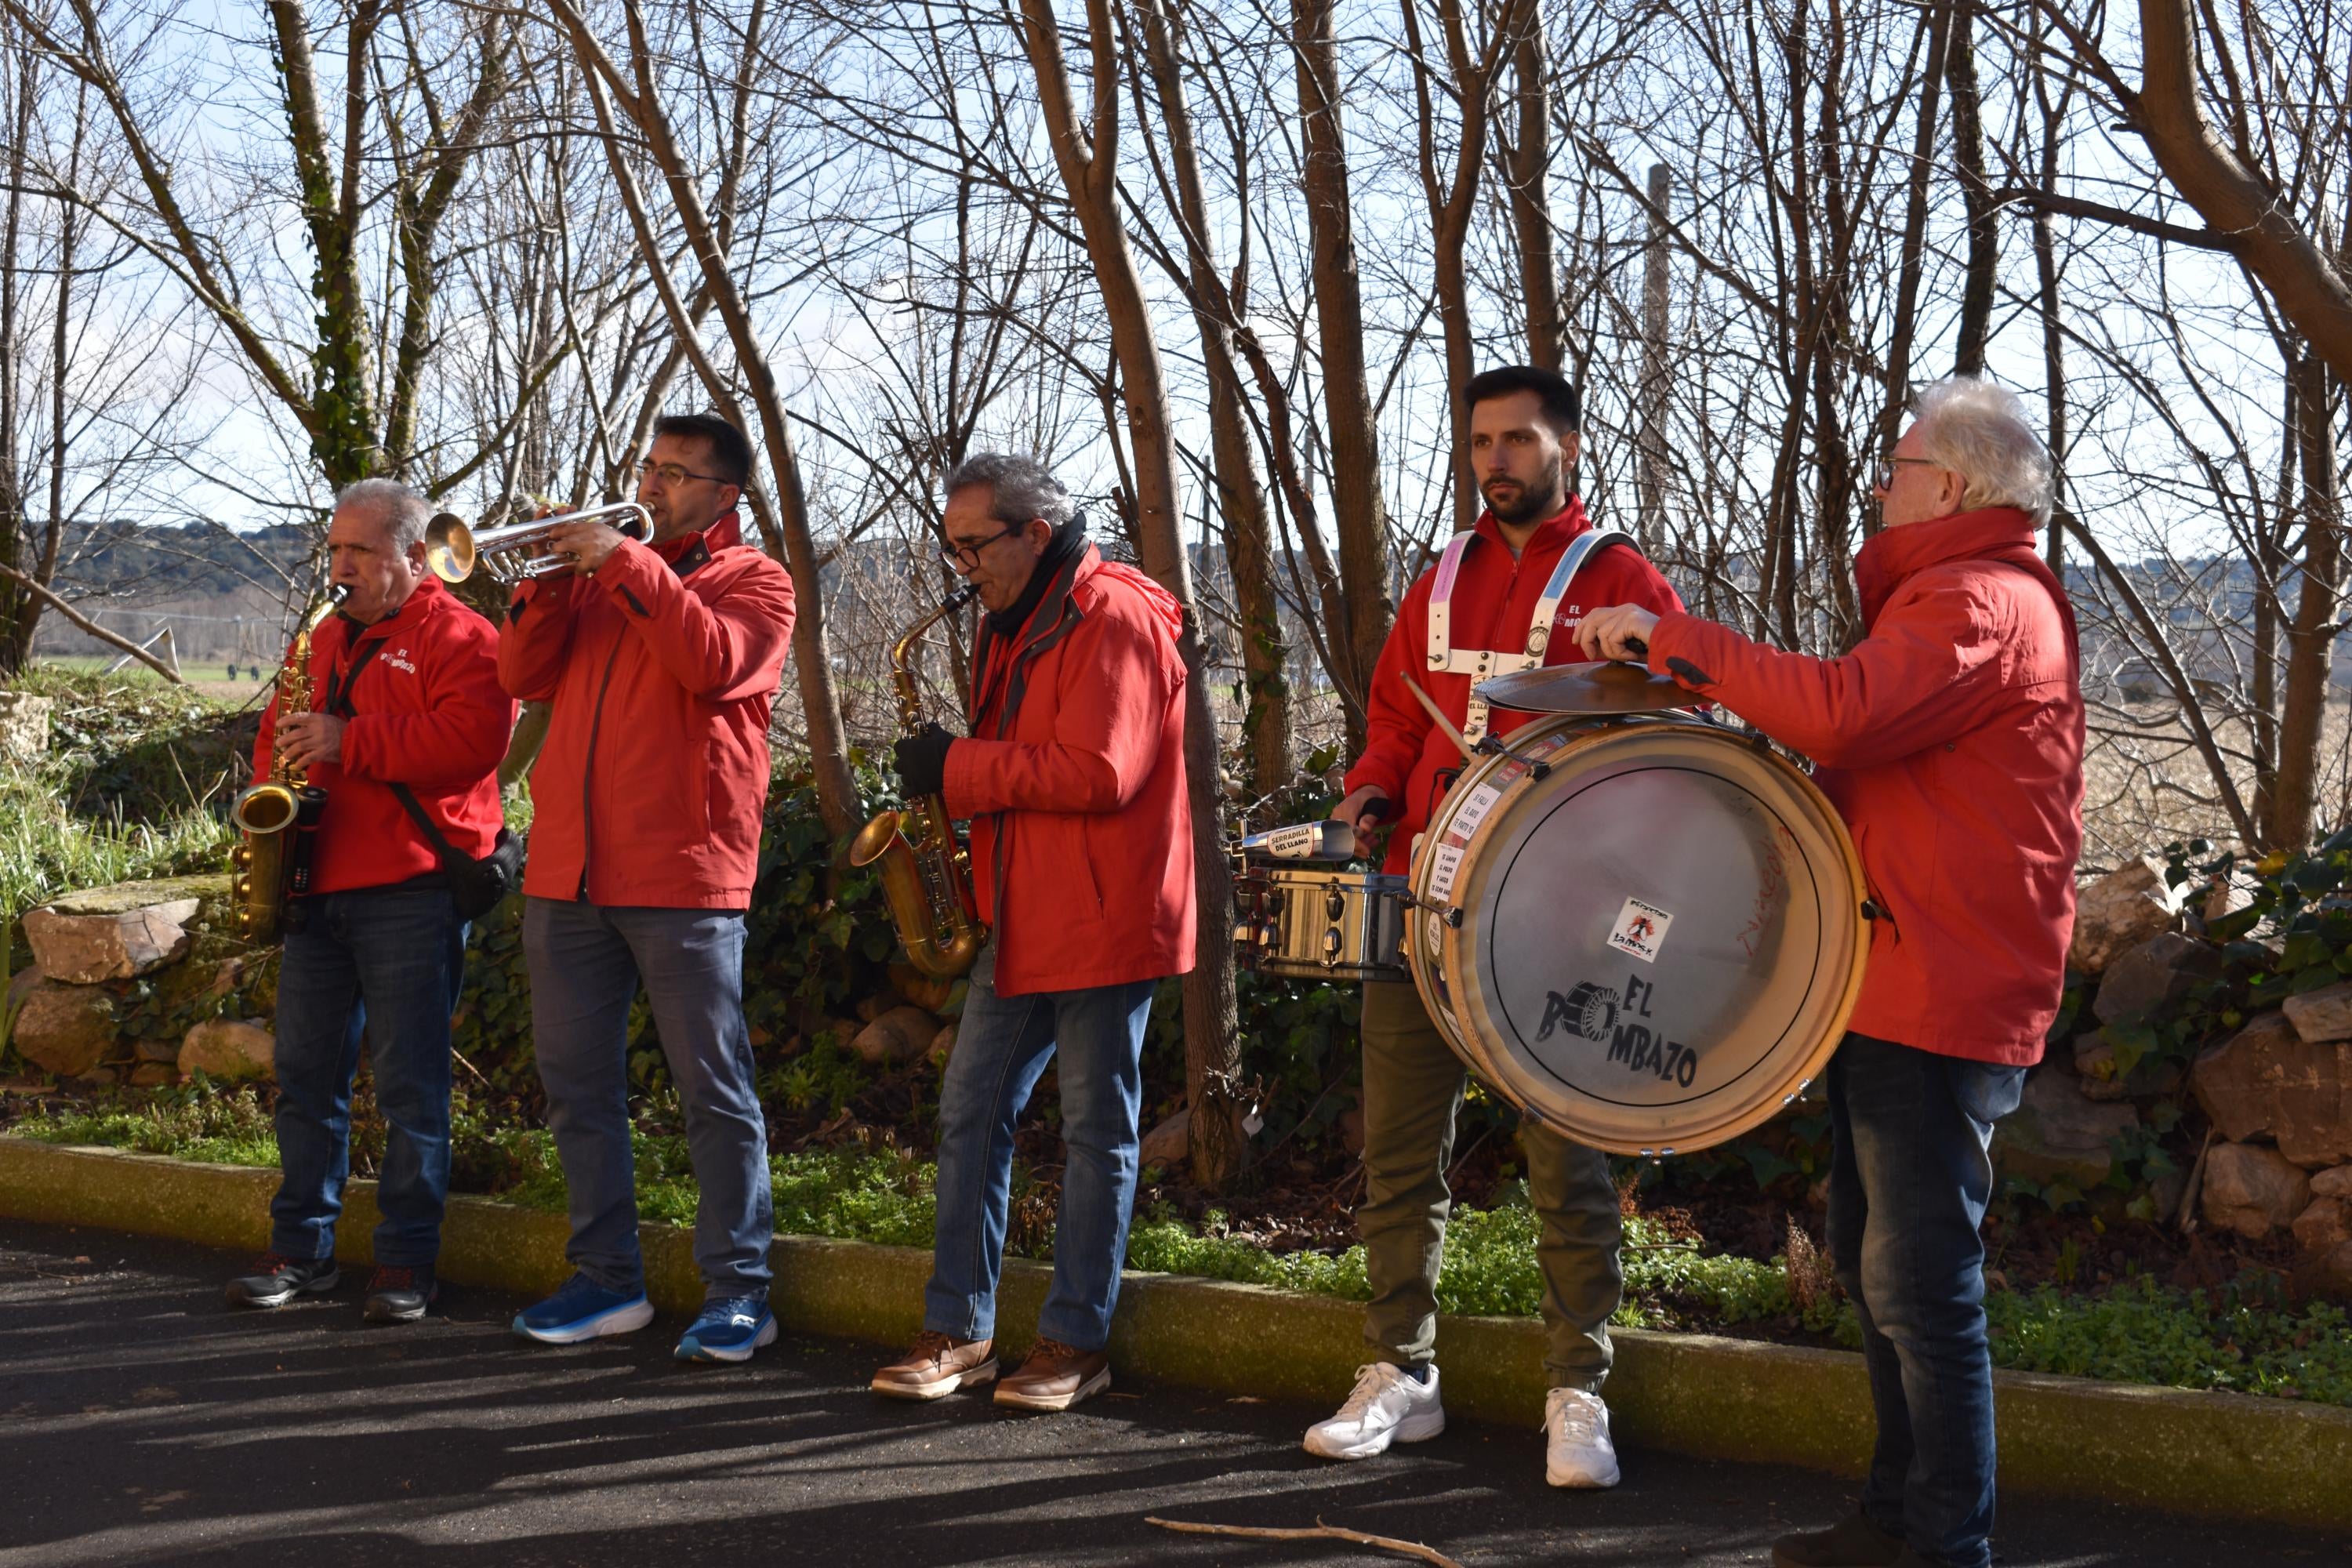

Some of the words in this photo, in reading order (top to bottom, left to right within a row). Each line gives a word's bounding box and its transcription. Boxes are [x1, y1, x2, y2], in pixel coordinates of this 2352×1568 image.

[1569, 604, 1581, 615] EL
[397, 648, 408, 657] EL
[1271, 828, 1310, 844] SERRADILLA
[1275, 843, 1287, 851] DEL
[1288, 838, 1308, 848] LLANO
[1622, 974, 1653, 1018] EL
